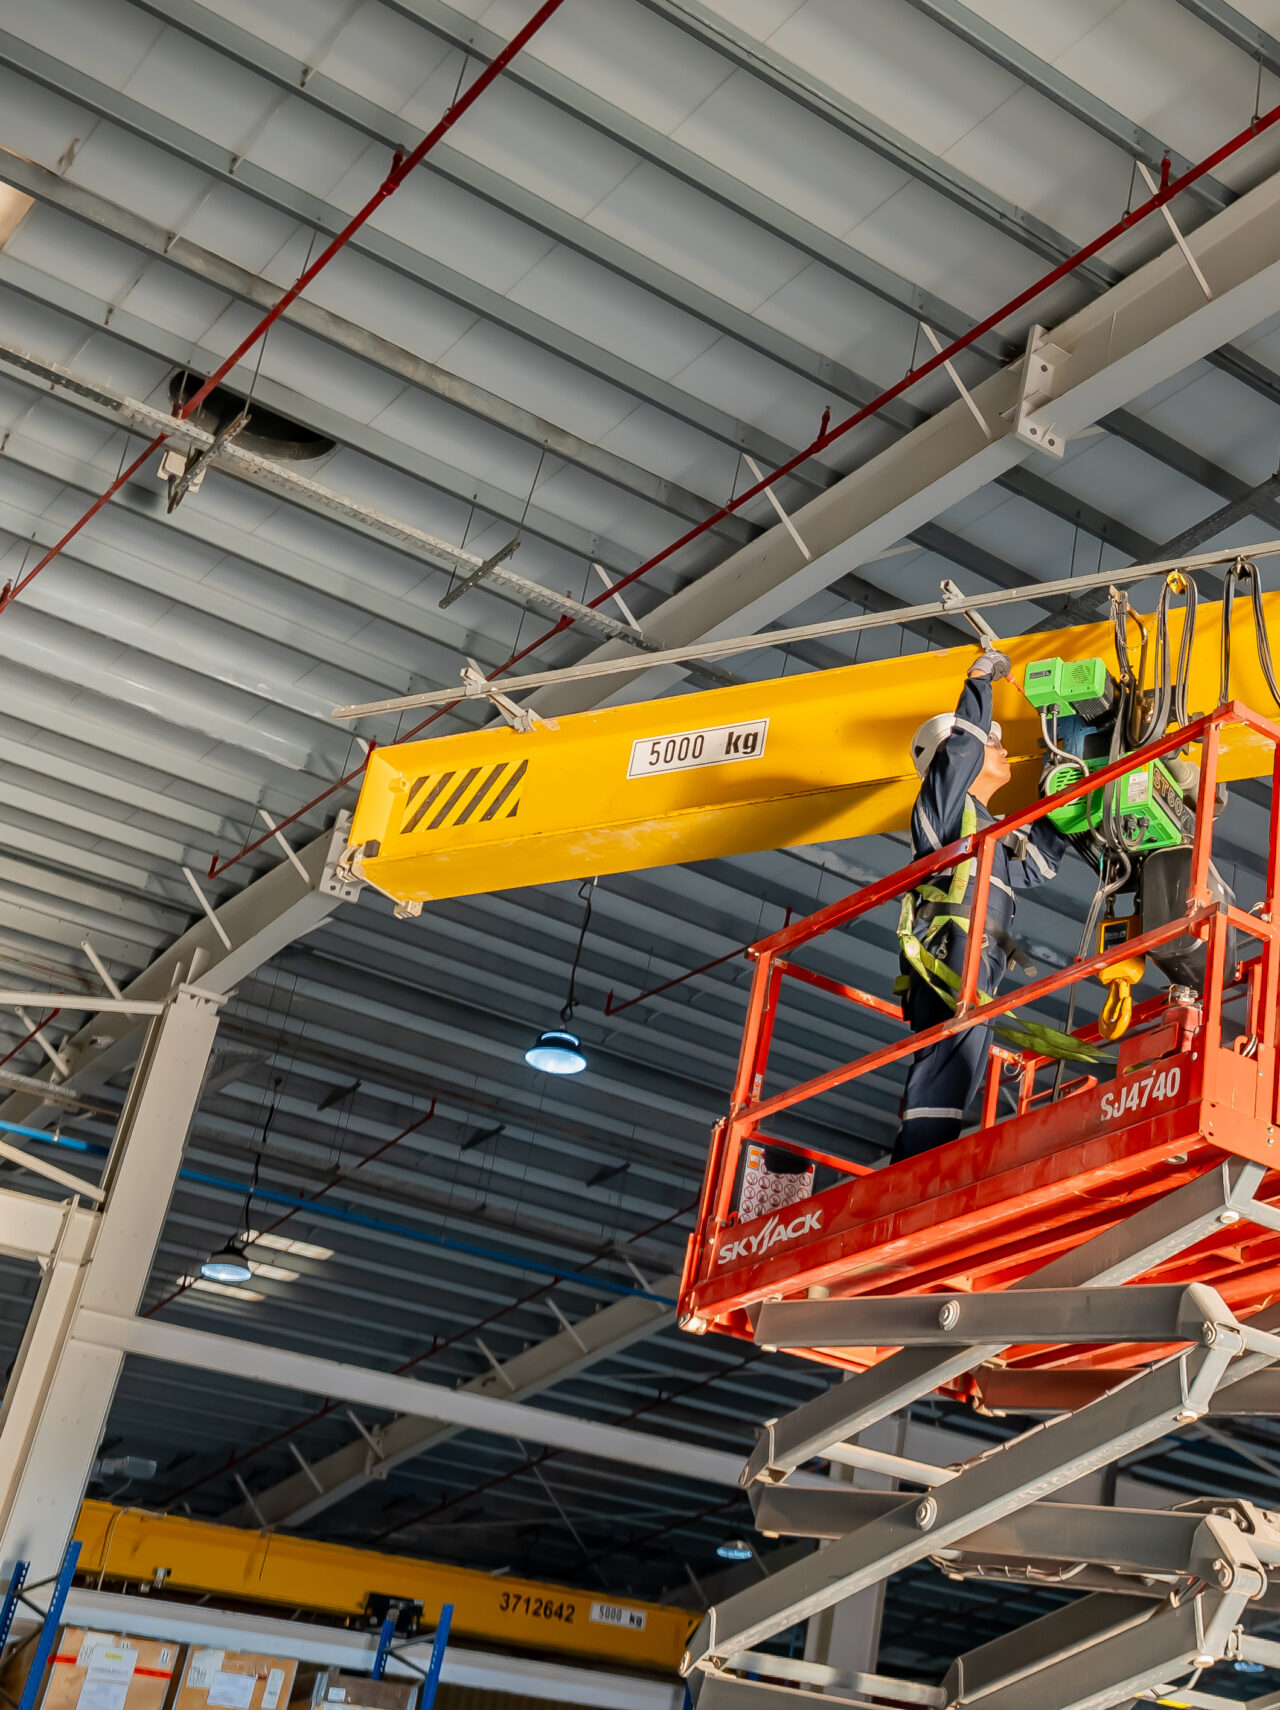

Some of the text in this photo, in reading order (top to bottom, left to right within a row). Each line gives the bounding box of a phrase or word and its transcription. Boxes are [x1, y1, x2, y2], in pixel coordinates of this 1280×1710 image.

[648, 731, 759, 766] 5000 kg
[1100, 1067, 1181, 1122] SJ4740
[717, 1209, 823, 1265] SKYJACK
[499, 1591, 576, 1624] 3712642
[599, 1605, 622, 1623] 5000
